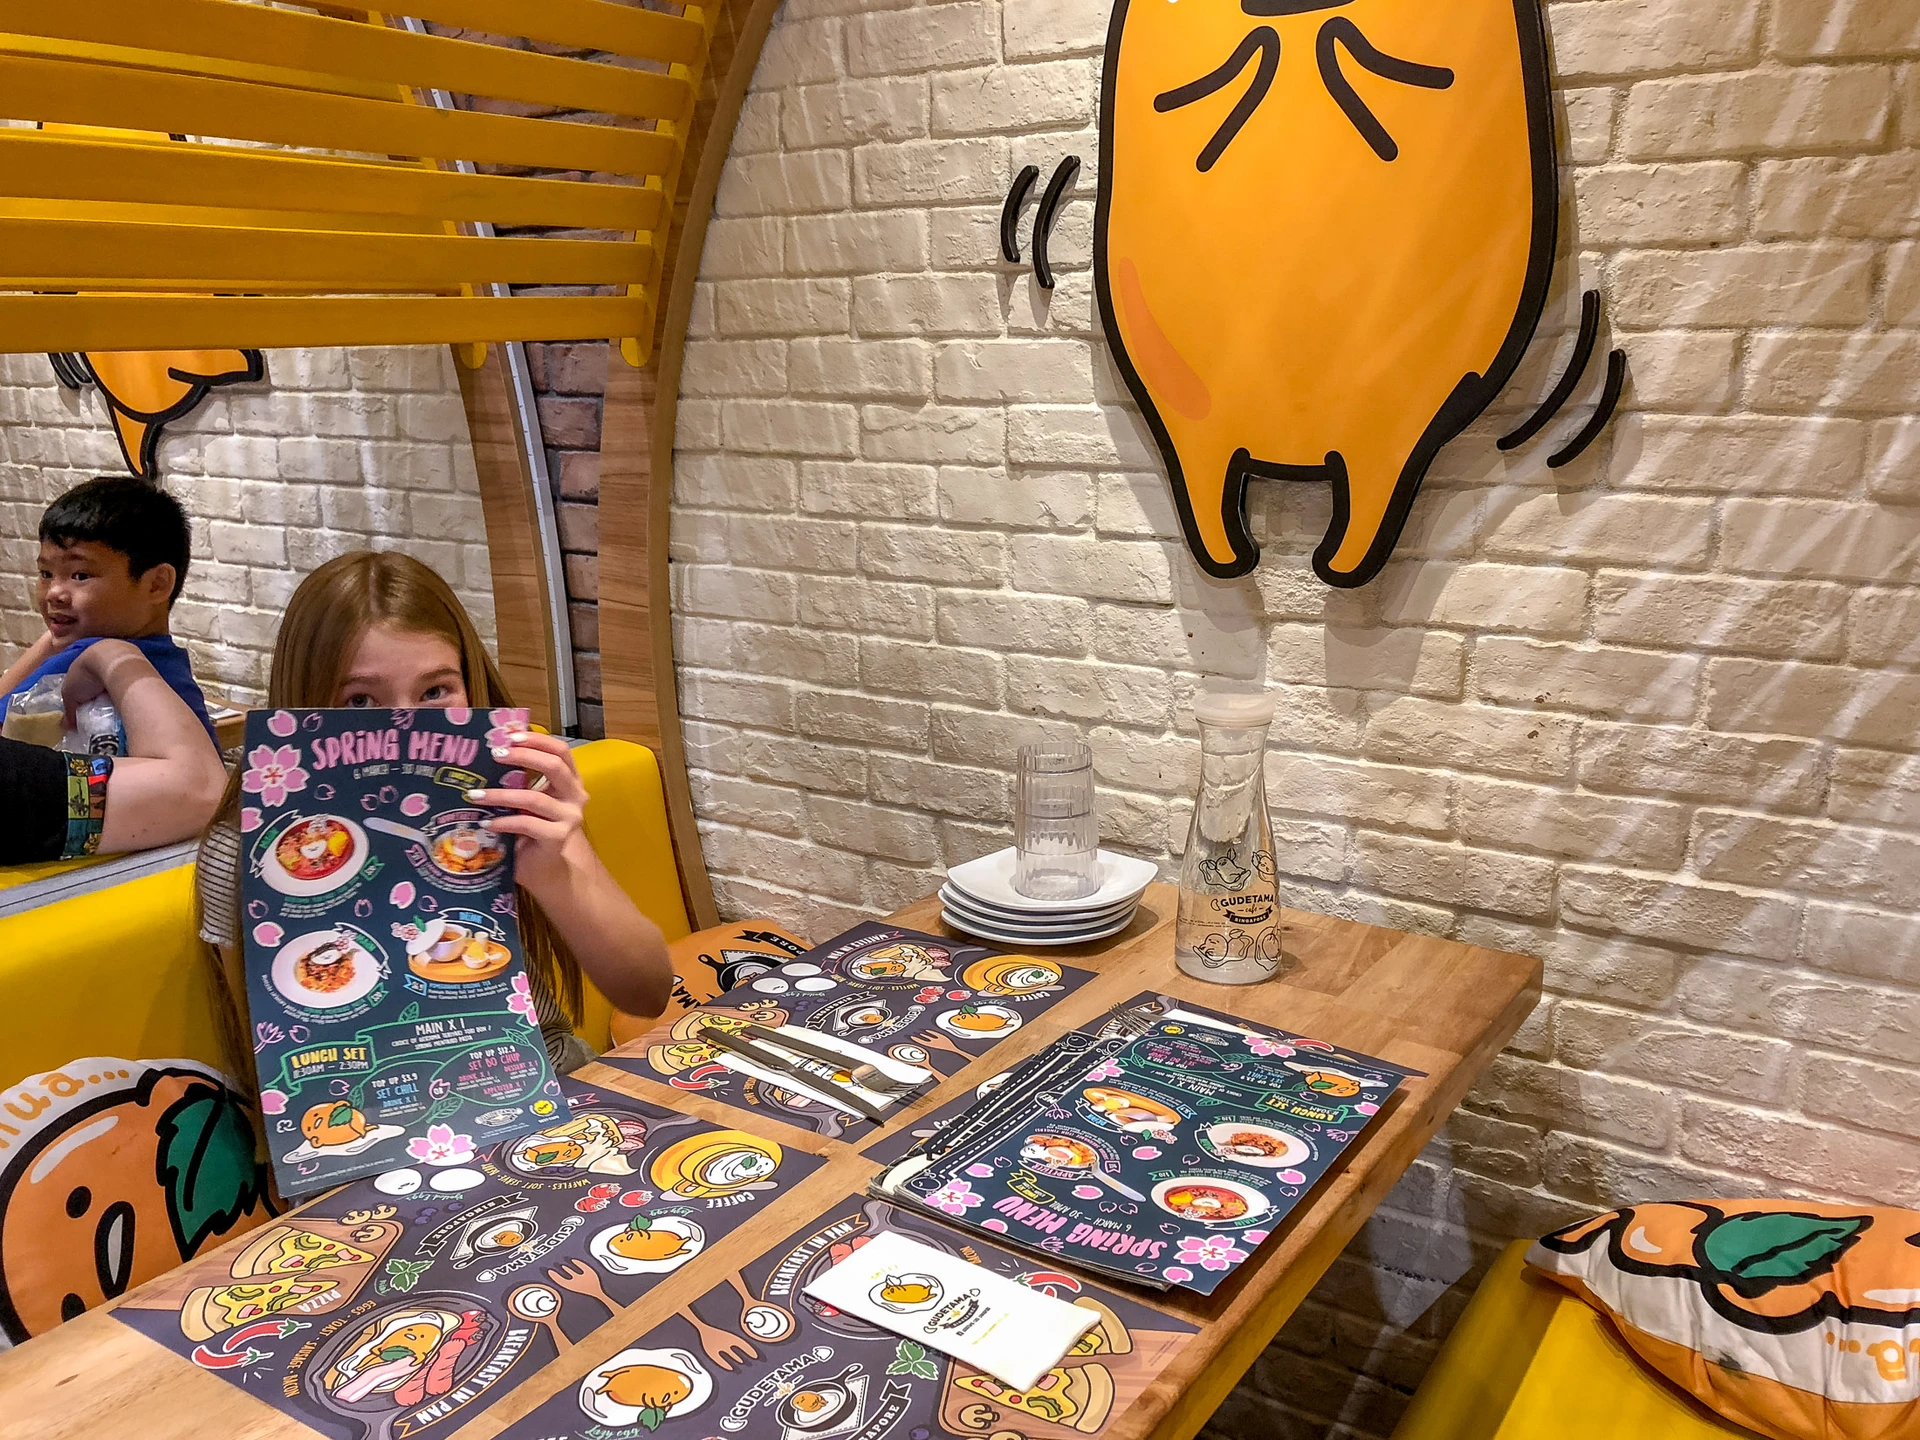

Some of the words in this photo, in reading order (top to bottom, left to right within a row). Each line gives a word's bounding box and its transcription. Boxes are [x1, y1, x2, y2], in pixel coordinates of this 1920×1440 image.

[408, 731, 480, 766] MENU
[1220, 894, 1274, 907] GUDETAMA
[415, 1021, 444, 1036] MAIN
[290, 1047, 338, 1069] LUNCH
[343, 1047, 367, 1061] SET
[469, 1051, 483, 1060] TOP
[485, 1049, 495, 1057] UP
[468, 1060, 483, 1071] SET
[371, 1079, 386, 1089] TOP
[388, 1076, 399, 1085] UP
[376, 1088, 392, 1100] SET
[394, 1082, 419, 1095] CHILL
[1187, 1083, 1216, 1096] MAIN
[1265, 1100, 1289, 1110] SET
[1290, 1106, 1334, 1121] LUNCH
[521, 1182, 545, 1190] SOFT
[552, 1178, 591, 1190] WAFFLES
[705, 1191, 756, 1209] COFFEE
[1049, 1201, 1071, 1214] APRIL
[432, 1201, 497, 1241] SINGAPORE
[993, 1196, 1068, 1234] MENU
[1069, 1209, 1083, 1220] 30
[1093, 1217, 1121, 1230] MARCH
[1125, 1224, 1132, 1232] 6
[493, 1223, 576, 1276] GUDETAMA
[769, 1246, 815, 1296] BREAKFAST
[807, 1236, 828, 1249] IN
[824, 1222, 853, 1240] PAN
[297, 1288, 342, 1313] PIZZA
[350, 1299, 377, 1316] EGGS
[927, 1293, 971, 1327] GUDETAMA
[319, 1318, 347, 1337] TOAST
[286, 1341, 318, 1370] SAUSAGE
[470, 1328, 530, 1388] BREAKFAST
[731, 1353, 819, 1418] GUDETAMA
[450, 1386, 476, 1404] IN
[415, 1400, 453, 1425] PAN
